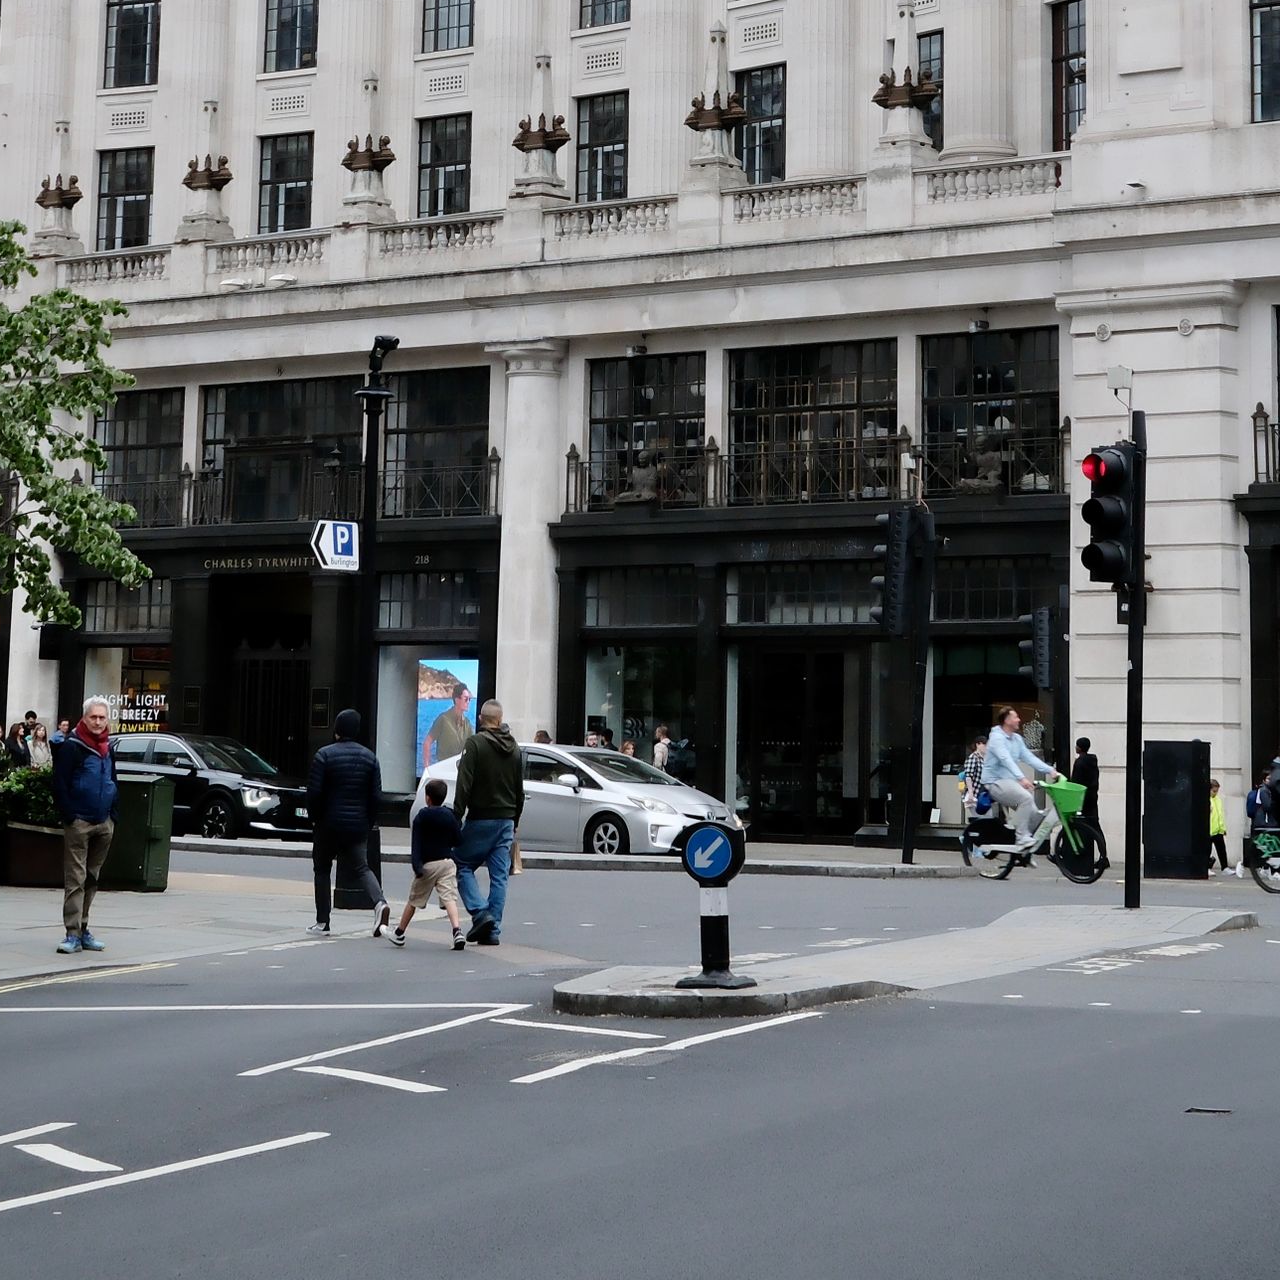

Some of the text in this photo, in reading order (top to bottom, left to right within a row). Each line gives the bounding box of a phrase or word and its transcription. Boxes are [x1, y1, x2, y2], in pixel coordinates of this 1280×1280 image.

[336, 525, 350, 553] P
[204, 556, 317, 569] CHARLES TYRWHITT
[330, 557, 358, 568] Burlington
[415, 554, 430, 565] 218
[135, 694, 166, 706] LIGHT
[122, 708, 160, 720] BREEZY
[110, 723, 161, 733] TYRWHITT
